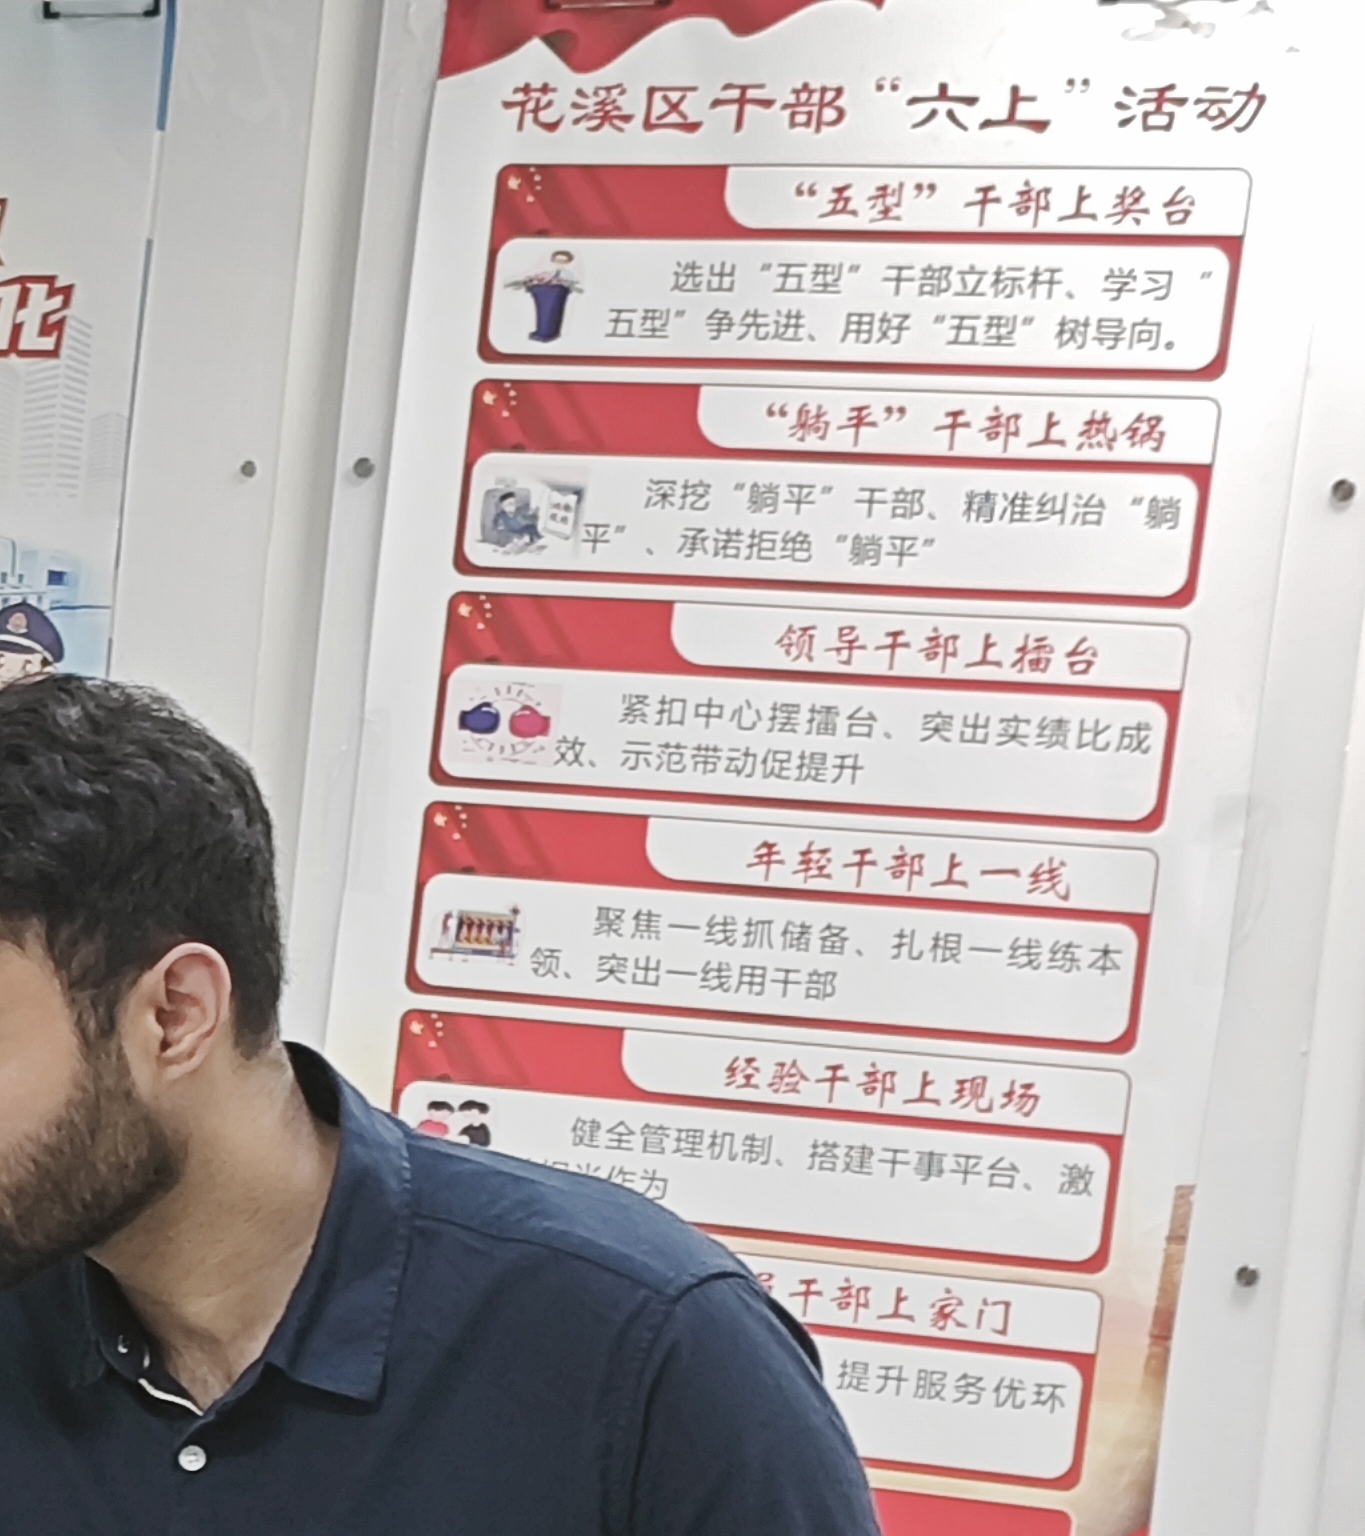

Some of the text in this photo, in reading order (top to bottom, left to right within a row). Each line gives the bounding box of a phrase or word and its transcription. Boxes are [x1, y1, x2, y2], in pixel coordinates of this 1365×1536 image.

[500, 77, 1269, 134] 花溪区干部“六上”活动
[793, 181, 1196, 228] “五型”干部上奖台
[766, 402, 1168, 454] “躺平”干部上热锅
[776, 624, 1100, 677] 领导干部上擂台
[620, 692, 1153, 756] 紧扣中心摆擂台、突出实绩比成
[555, 735, 865, 786] 效、示范带动促提升
[747, 841, 1072, 902] 年轻干部上一线
[593, 906, 1123, 977] 聚焦一线抓储备、扎根一线练本
[529, 947, 837, 1000] 领、突出一线用干部
[725, 1053, 1042, 1115] 经验干部上现场
[571, 1116, 1095, 1199] 健全管理机制、搭建干事平台、激
[836, 1358, 1067, 1415] 提升服务优环
